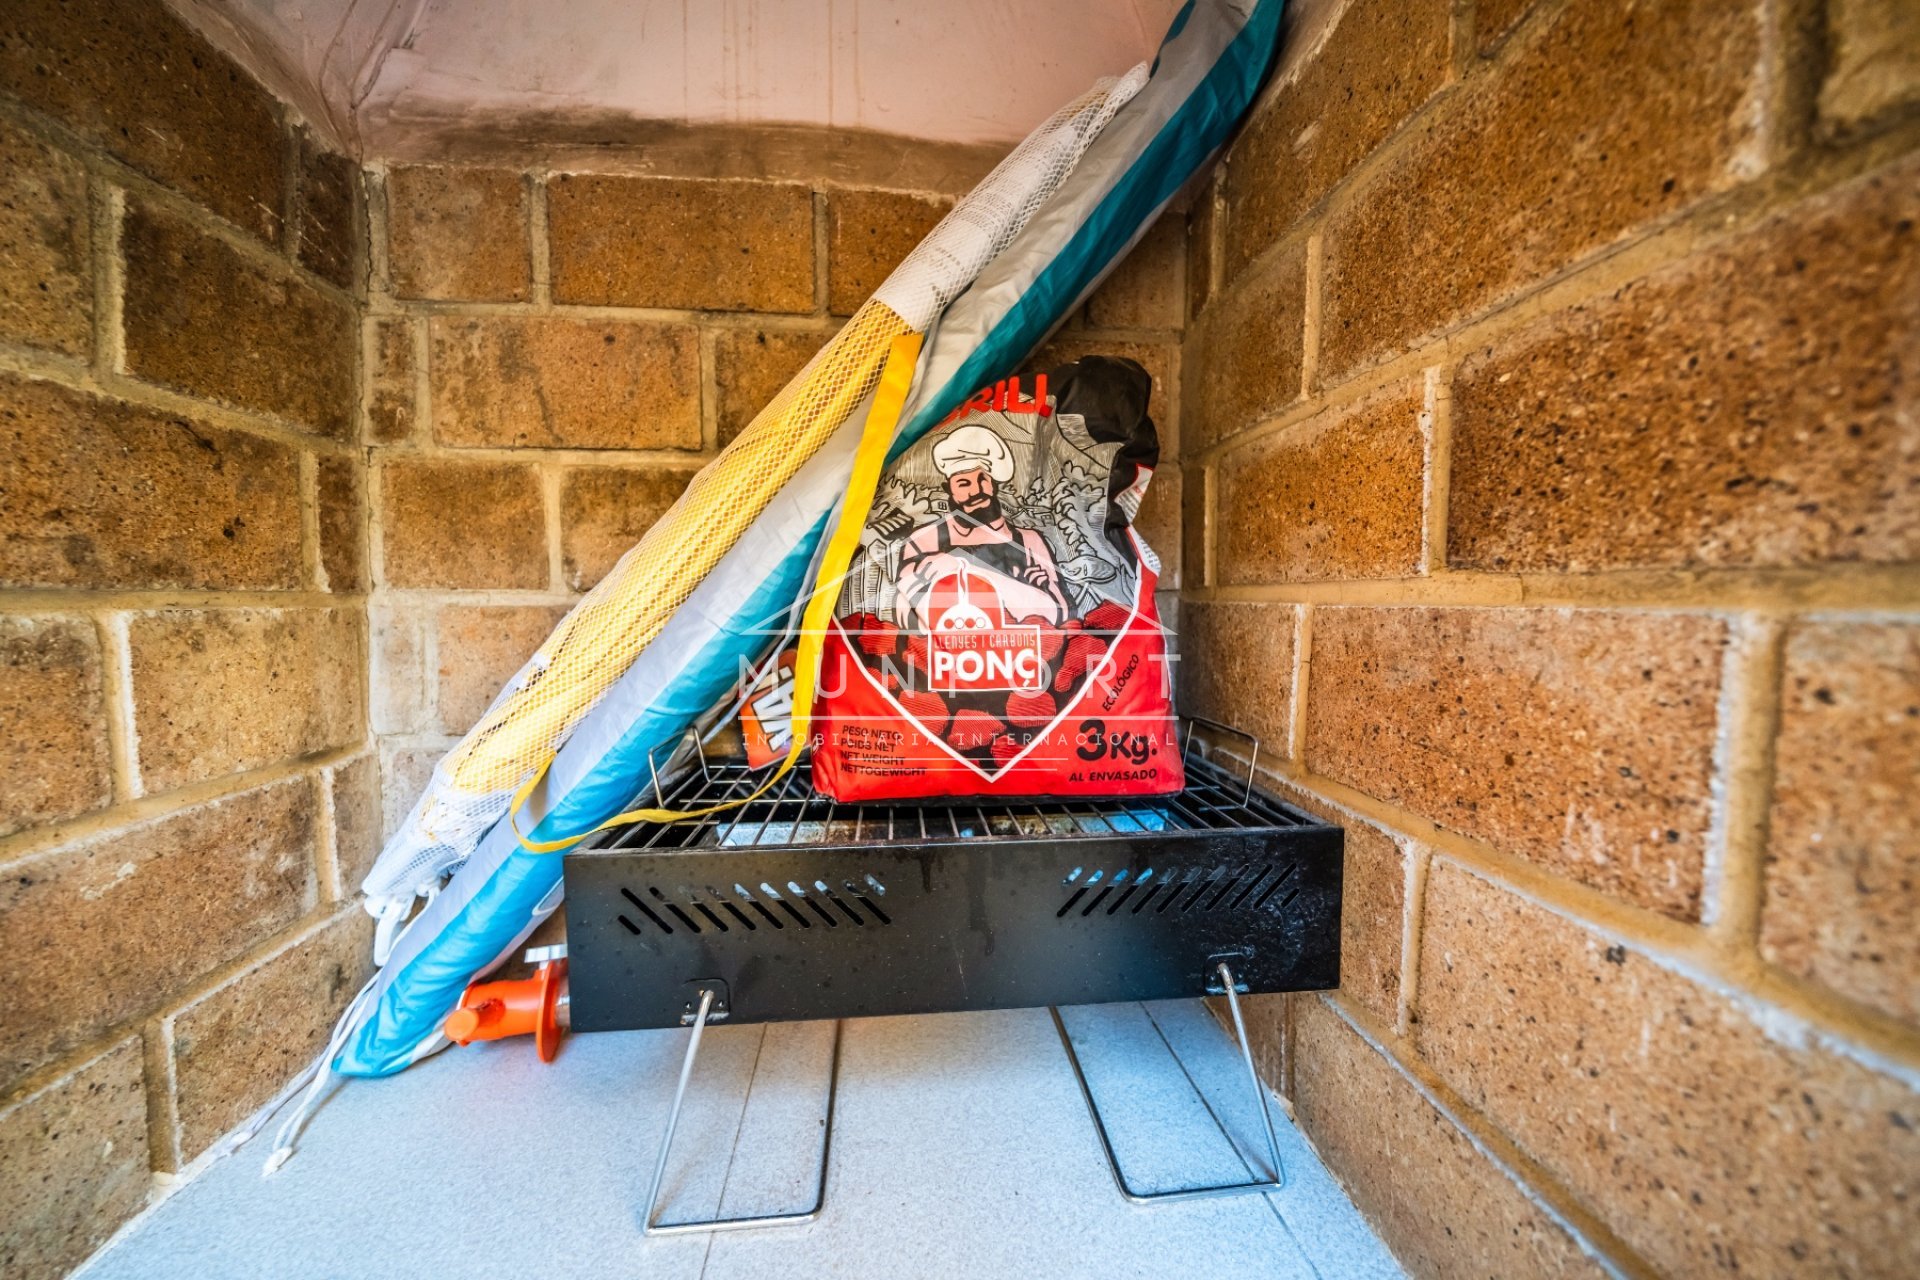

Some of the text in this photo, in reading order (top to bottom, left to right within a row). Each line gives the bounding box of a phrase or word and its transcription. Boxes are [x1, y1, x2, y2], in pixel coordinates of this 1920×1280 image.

[933, 647, 1036, 688] PONÇ
[1101, 653, 1140, 713] ECOLÓGICO
[842, 724, 902, 742] PESO NETO
[874, 742, 897, 753] NET
[839, 750, 906, 766] NET WEIGHT
[1068, 768, 1158, 783] AL ENVASADO
